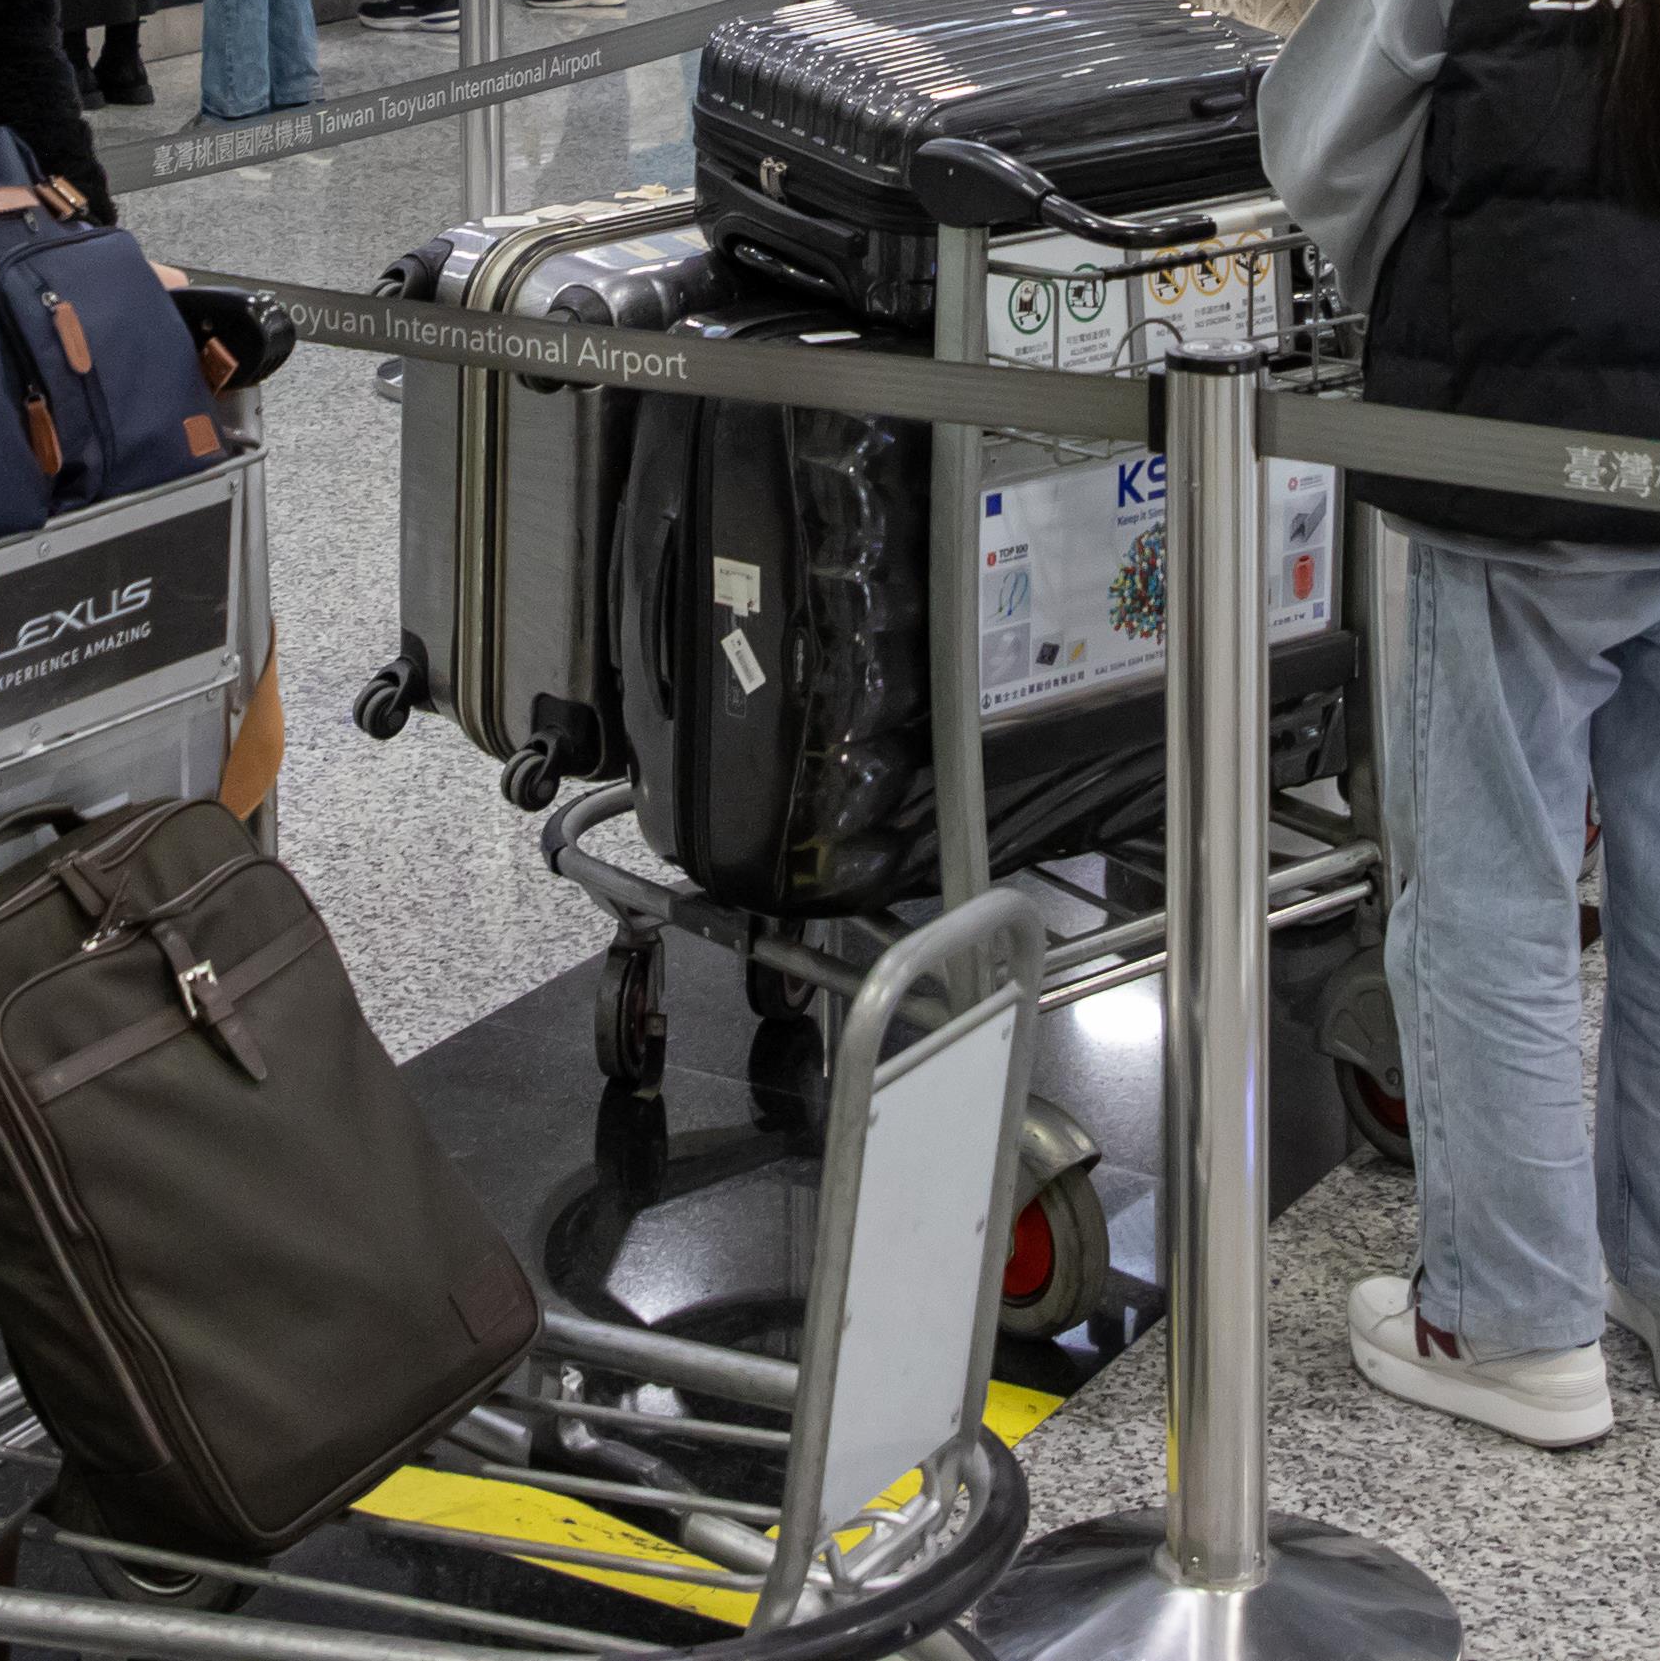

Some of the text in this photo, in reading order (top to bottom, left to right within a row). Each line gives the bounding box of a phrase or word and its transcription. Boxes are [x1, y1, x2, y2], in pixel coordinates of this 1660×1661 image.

[152, 47, 602, 178] 臺灣桃園國際機場 Taiwan Taoyuan International Airport
[385, 308, 570, 367] International
[577, 339, 689, 383] Airport
[999, 543, 1029, 559] TOP 100
[83, 620, 152, 662] AMAZING
